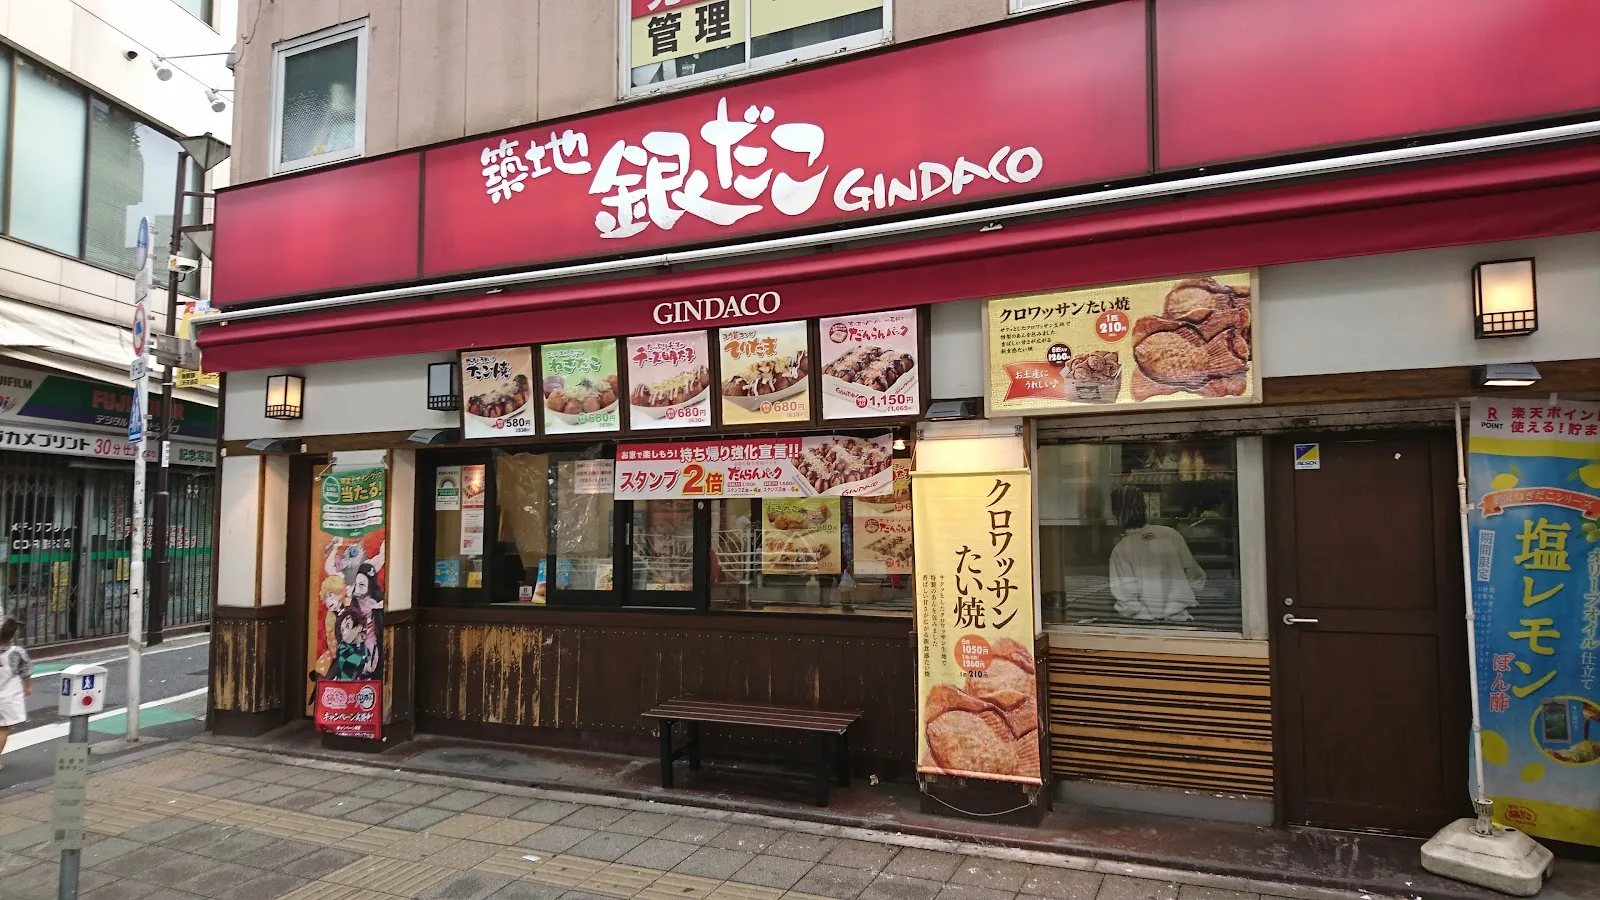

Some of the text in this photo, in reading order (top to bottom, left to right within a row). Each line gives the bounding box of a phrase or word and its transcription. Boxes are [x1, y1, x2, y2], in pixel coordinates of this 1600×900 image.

[647, 3, 731, 56] 管理
[480, 96, 1043, 239] 築地 銀だこ GINDACO
[653, 291, 781, 326] GINDACO
[1000, 296, 1130, 323] クロワッサンたい焼
[848, 325, 909, 342] だんらんパック
[724, 337, 778, 359] てりたま
[1014, 368, 1049, 380] お土産に
[773, 401, 805, 411] 680円
[869, 394, 914, 407] 1,150円
[505, 418, 531, 428] 580円
[1481, 422, 1504, 430] POINT
[680, 443, 800, 462] 持ち帰り強化宣言!!
[728, 466, 782, 480] だんらんパック
[986, 478, 1018, 630] クロワッサン
[1478, 531, 1494, 581] 期間限定
[953, 545, 986, 630] たい焼
[1508, 517, 1572, 698] 塩レモン
[1490, 653, 1515, 713] ぽん酢
